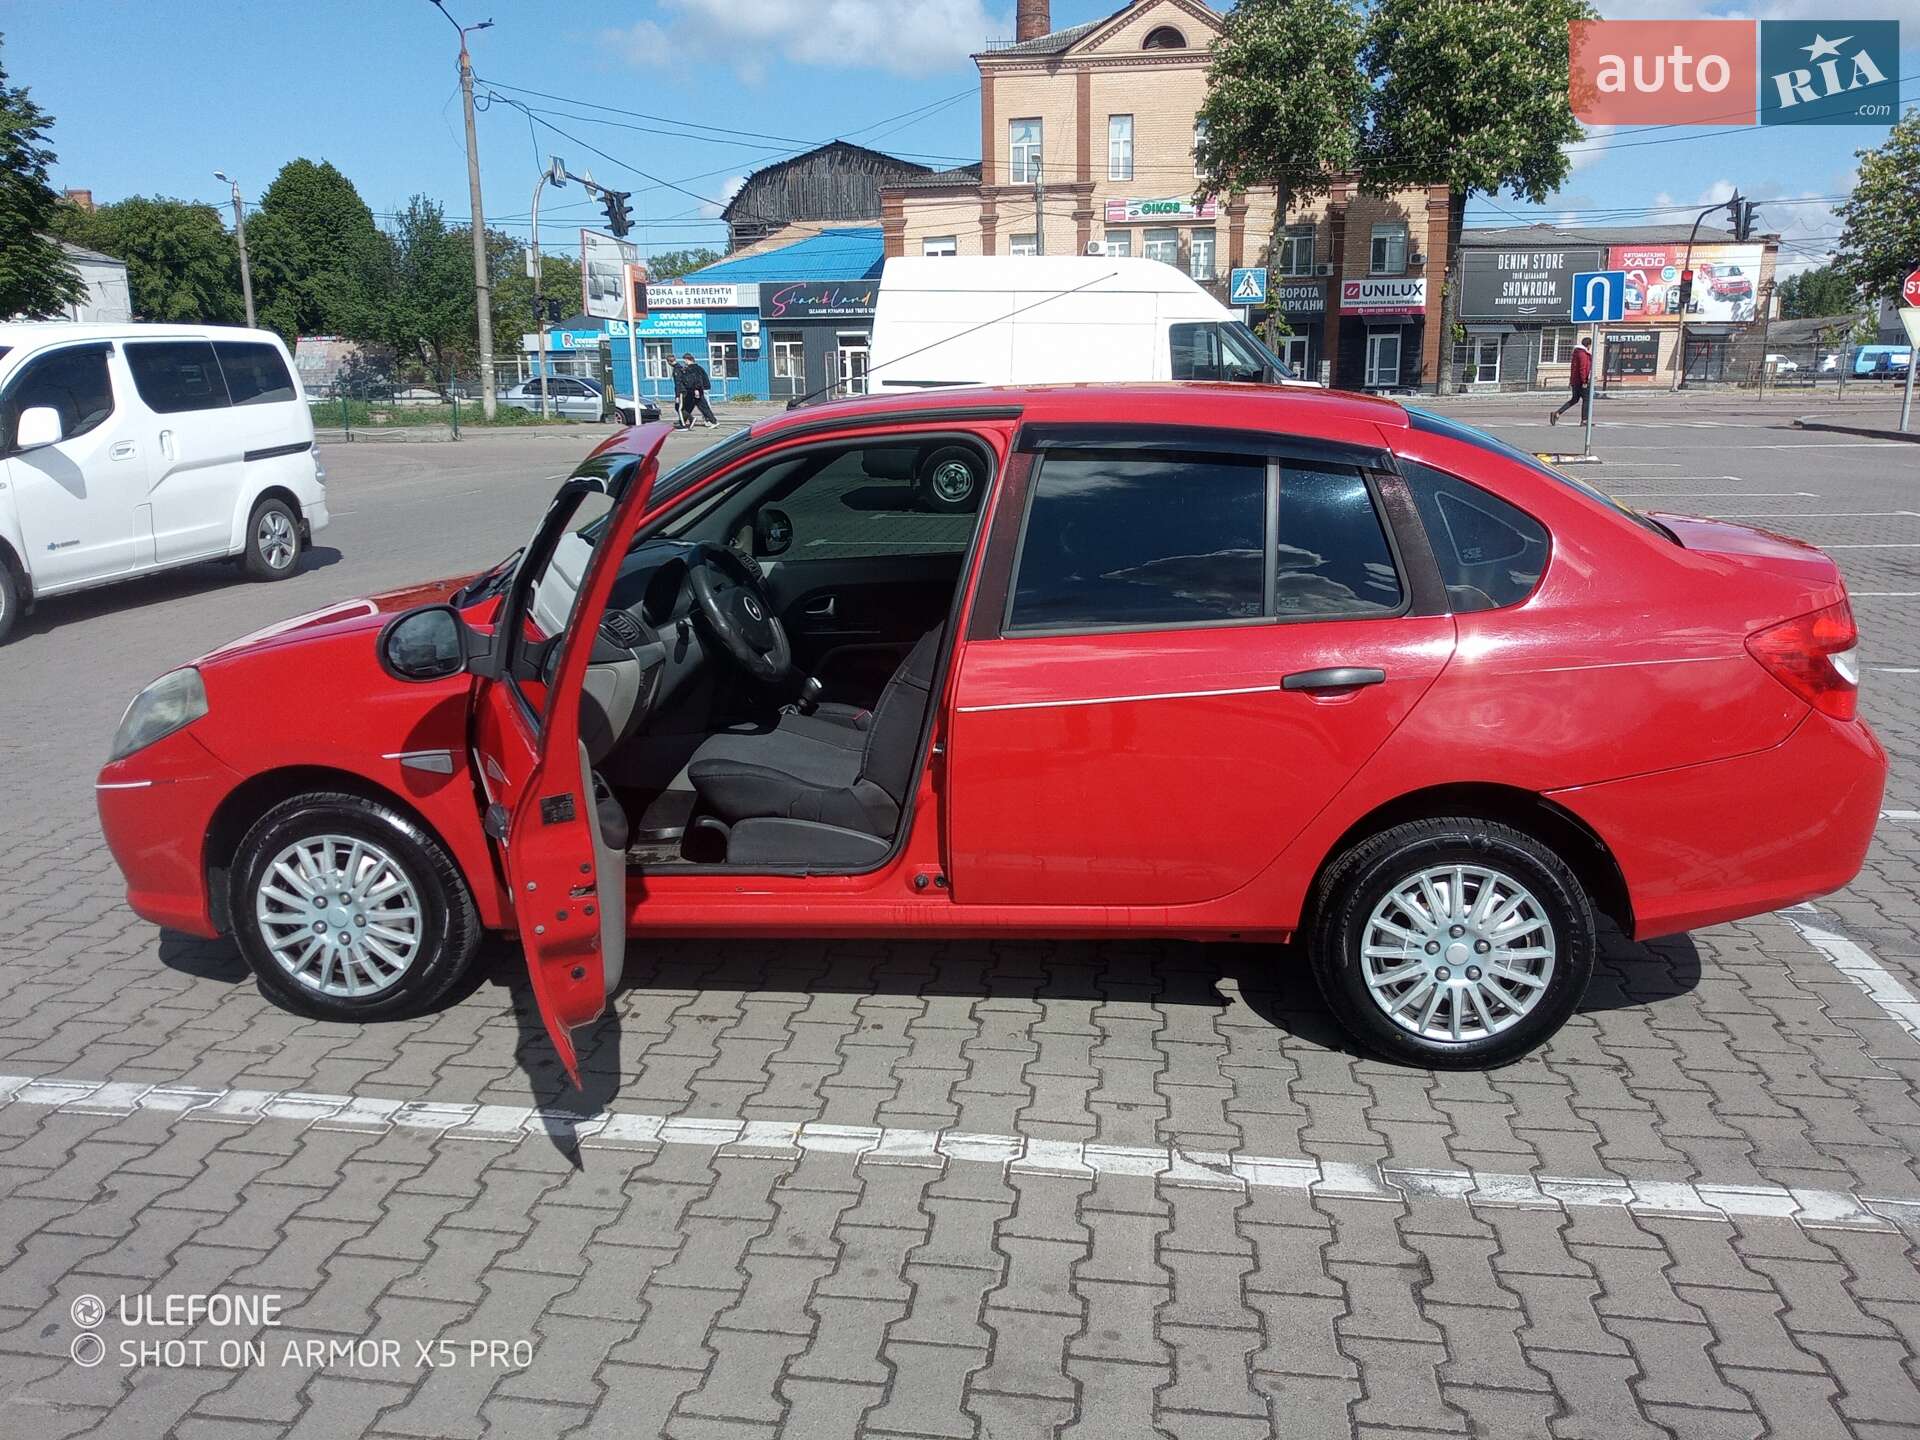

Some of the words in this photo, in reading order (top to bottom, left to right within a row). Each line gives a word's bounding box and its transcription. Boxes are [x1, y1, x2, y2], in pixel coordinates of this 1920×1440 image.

[1497, 254, 1529, 270] DENIM
[1533, 253, 1564, 269] STORE
[1623, 257, 1666, 267] XADO
[684, 287, 732, 295] ЕЛЕМЕНТИ
[1279, 287, 1319, 299] ВОРОТА
[1362, 283, 1424, 297] UNILUX
[1502, 281, 1556, 297] SHOWROOM
[648, 297, 684, 306] ВИРОБИ
[693, 297, 729, 305] МЕТАЛУ
